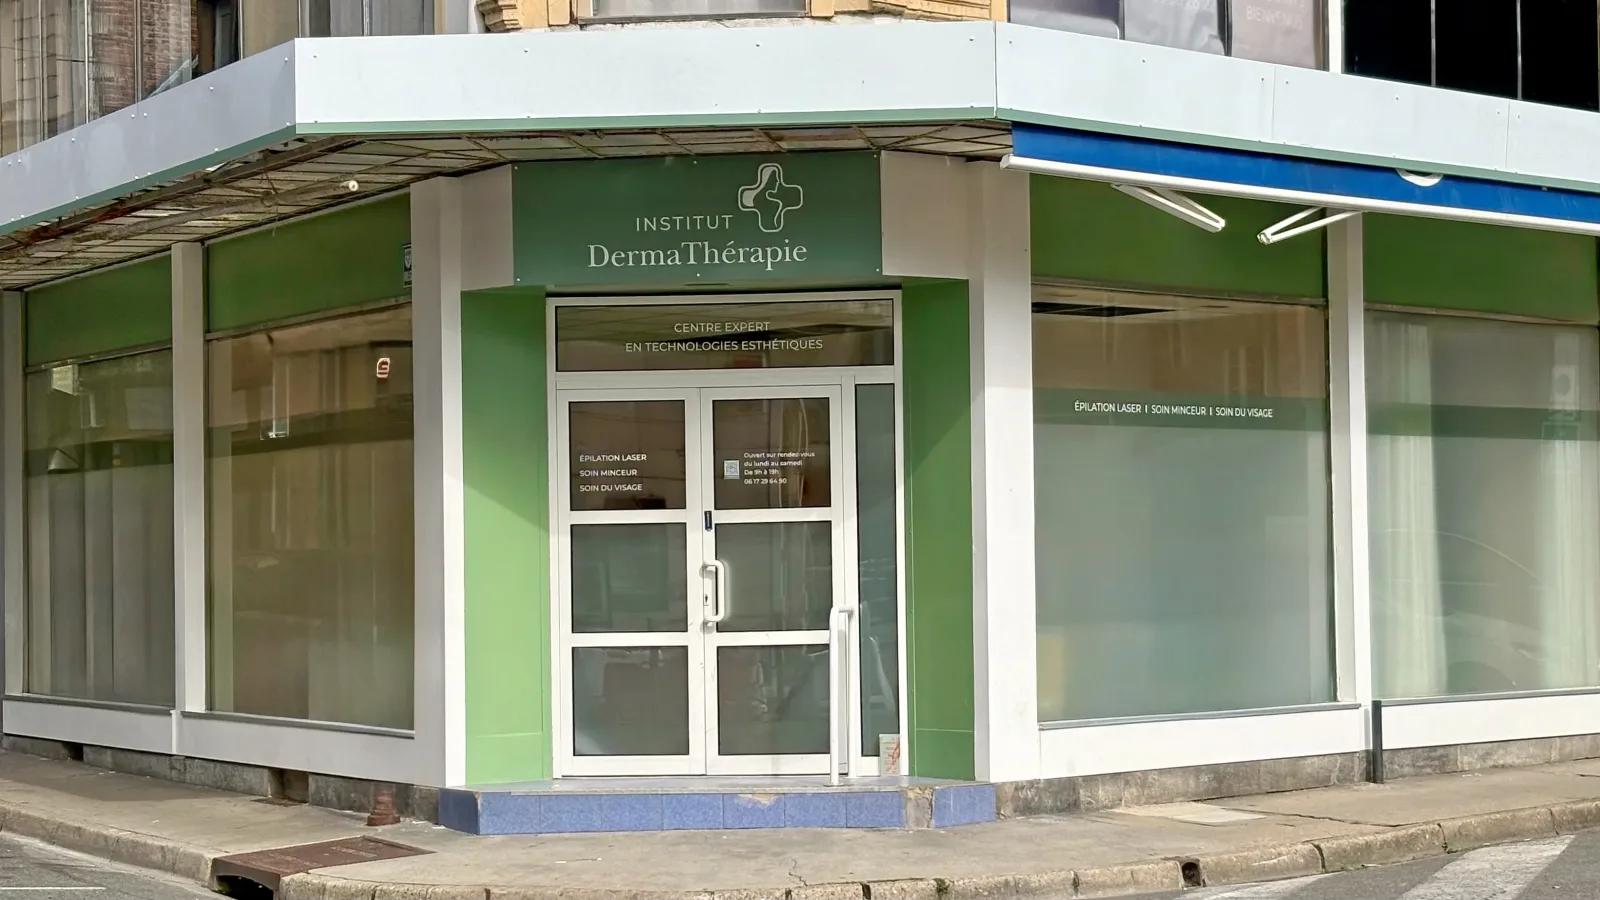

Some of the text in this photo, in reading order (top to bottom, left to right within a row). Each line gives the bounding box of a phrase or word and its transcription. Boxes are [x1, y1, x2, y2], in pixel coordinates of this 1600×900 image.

[636, 215, 734, 232] INSTITUT
[588, 238, 808, 271] DermaThérapie
[674, 321, 771, 333] CENTRE EXPERT
[626, 338, 823, 352] EN TECHNOLOGIES ESTHÉTIQUES
[1074, 400, 1116, 412] ÉPILATION
[1117, 403, 1142, 413] LASER
[1151, 404, 1170, 414] SOIN
[1171, 406, 1206, 415] MINCEUR
[1215, 406, 1234, 416] SOIN
[1234, 408, 1246, 416] DU
[1246, 408, 1272, 418] VISAGE
[580, 454, 620, 462] ÉPILATION
